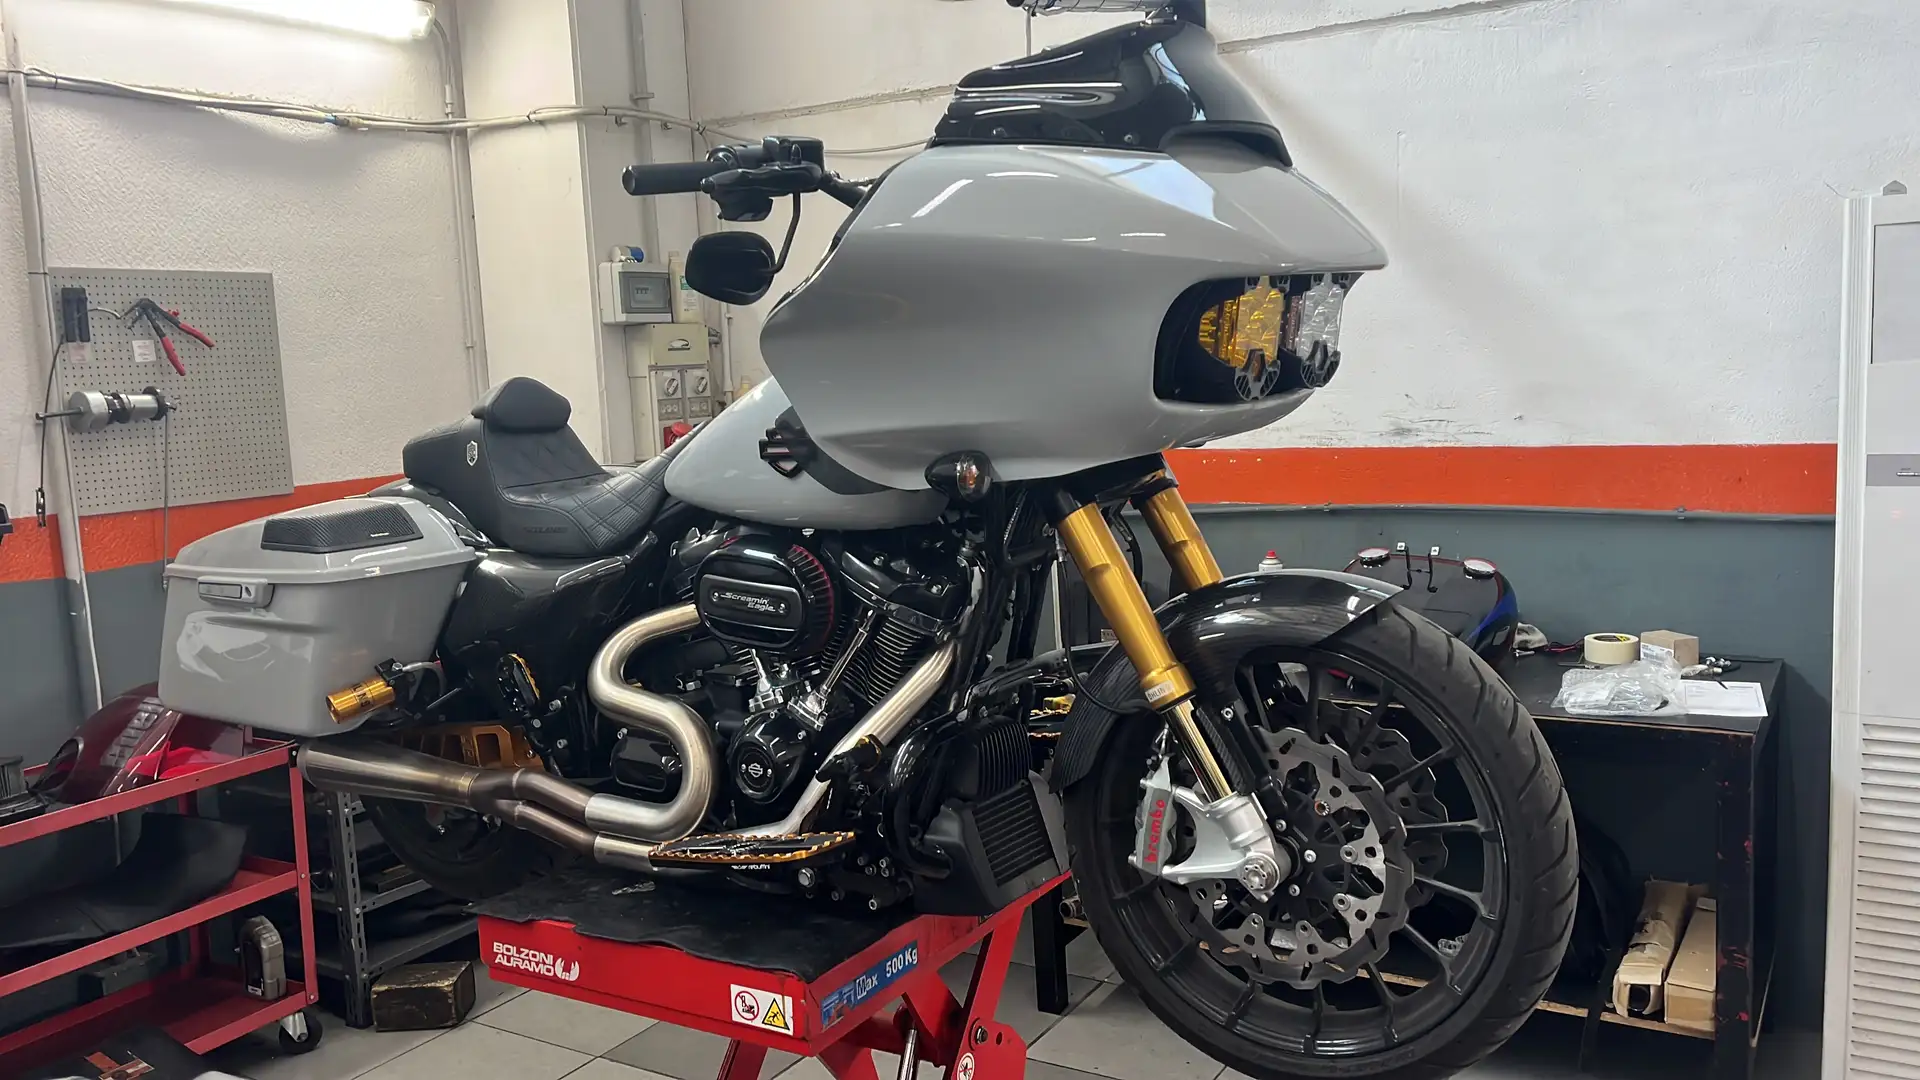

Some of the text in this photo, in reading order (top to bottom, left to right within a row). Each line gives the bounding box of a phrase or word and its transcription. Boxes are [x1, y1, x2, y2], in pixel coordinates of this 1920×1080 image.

[747, 602, 776, 611] Eagle
[1144, 799, 1166, 862] brembo
[493, 942, 554, 965] BOLZONI
[494, 954, 555, 977] AURAMO
[855, 947, 918, 1000] Max 500 Kg
